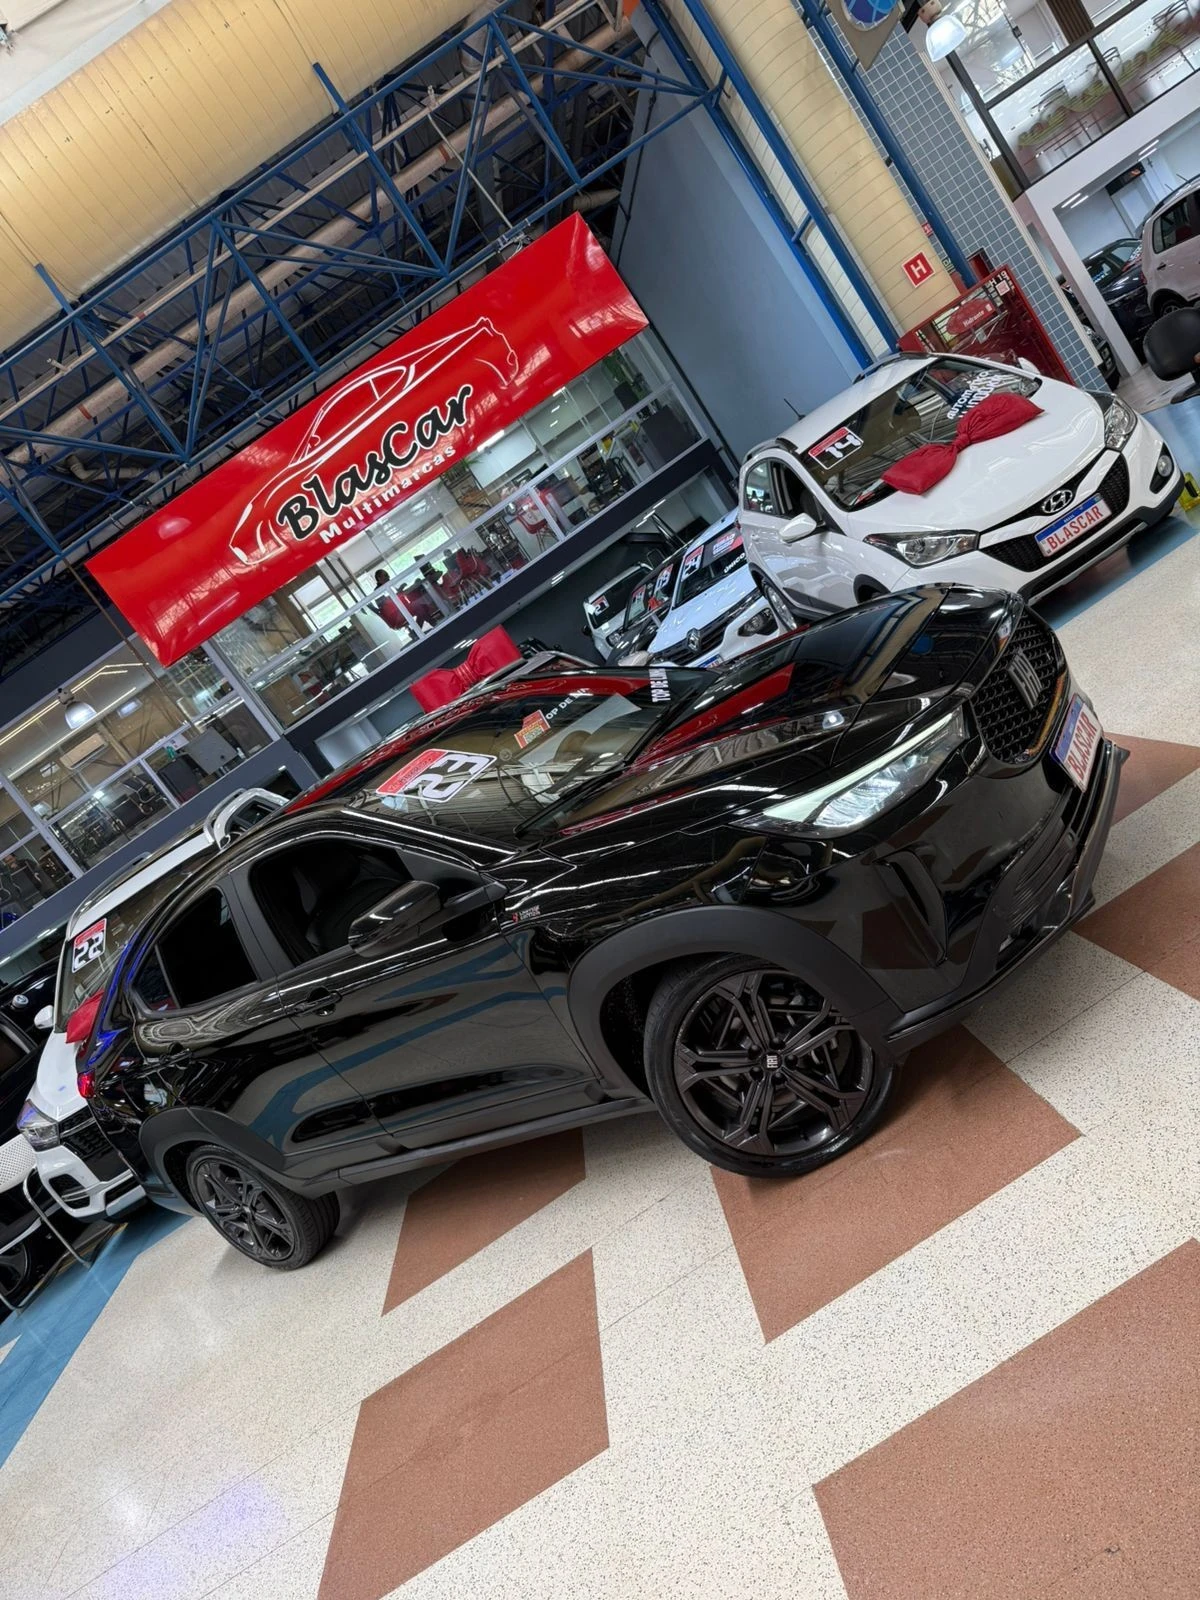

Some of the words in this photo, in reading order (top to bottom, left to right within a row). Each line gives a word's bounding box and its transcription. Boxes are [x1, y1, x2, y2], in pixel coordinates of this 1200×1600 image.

[910, 260, 927, 279] H
[277, 384, 474, 541] BlasCar
[825, 433, 862, 459] 14
[318, 445, 456, 545] Multimarcas
[1046, 505, 1104, 550] BLASCAR
[545, 707, 559, 720] OP
[1067, 711, 1098, 781] BLASCAR
[406, 754, 490, 799] 23
